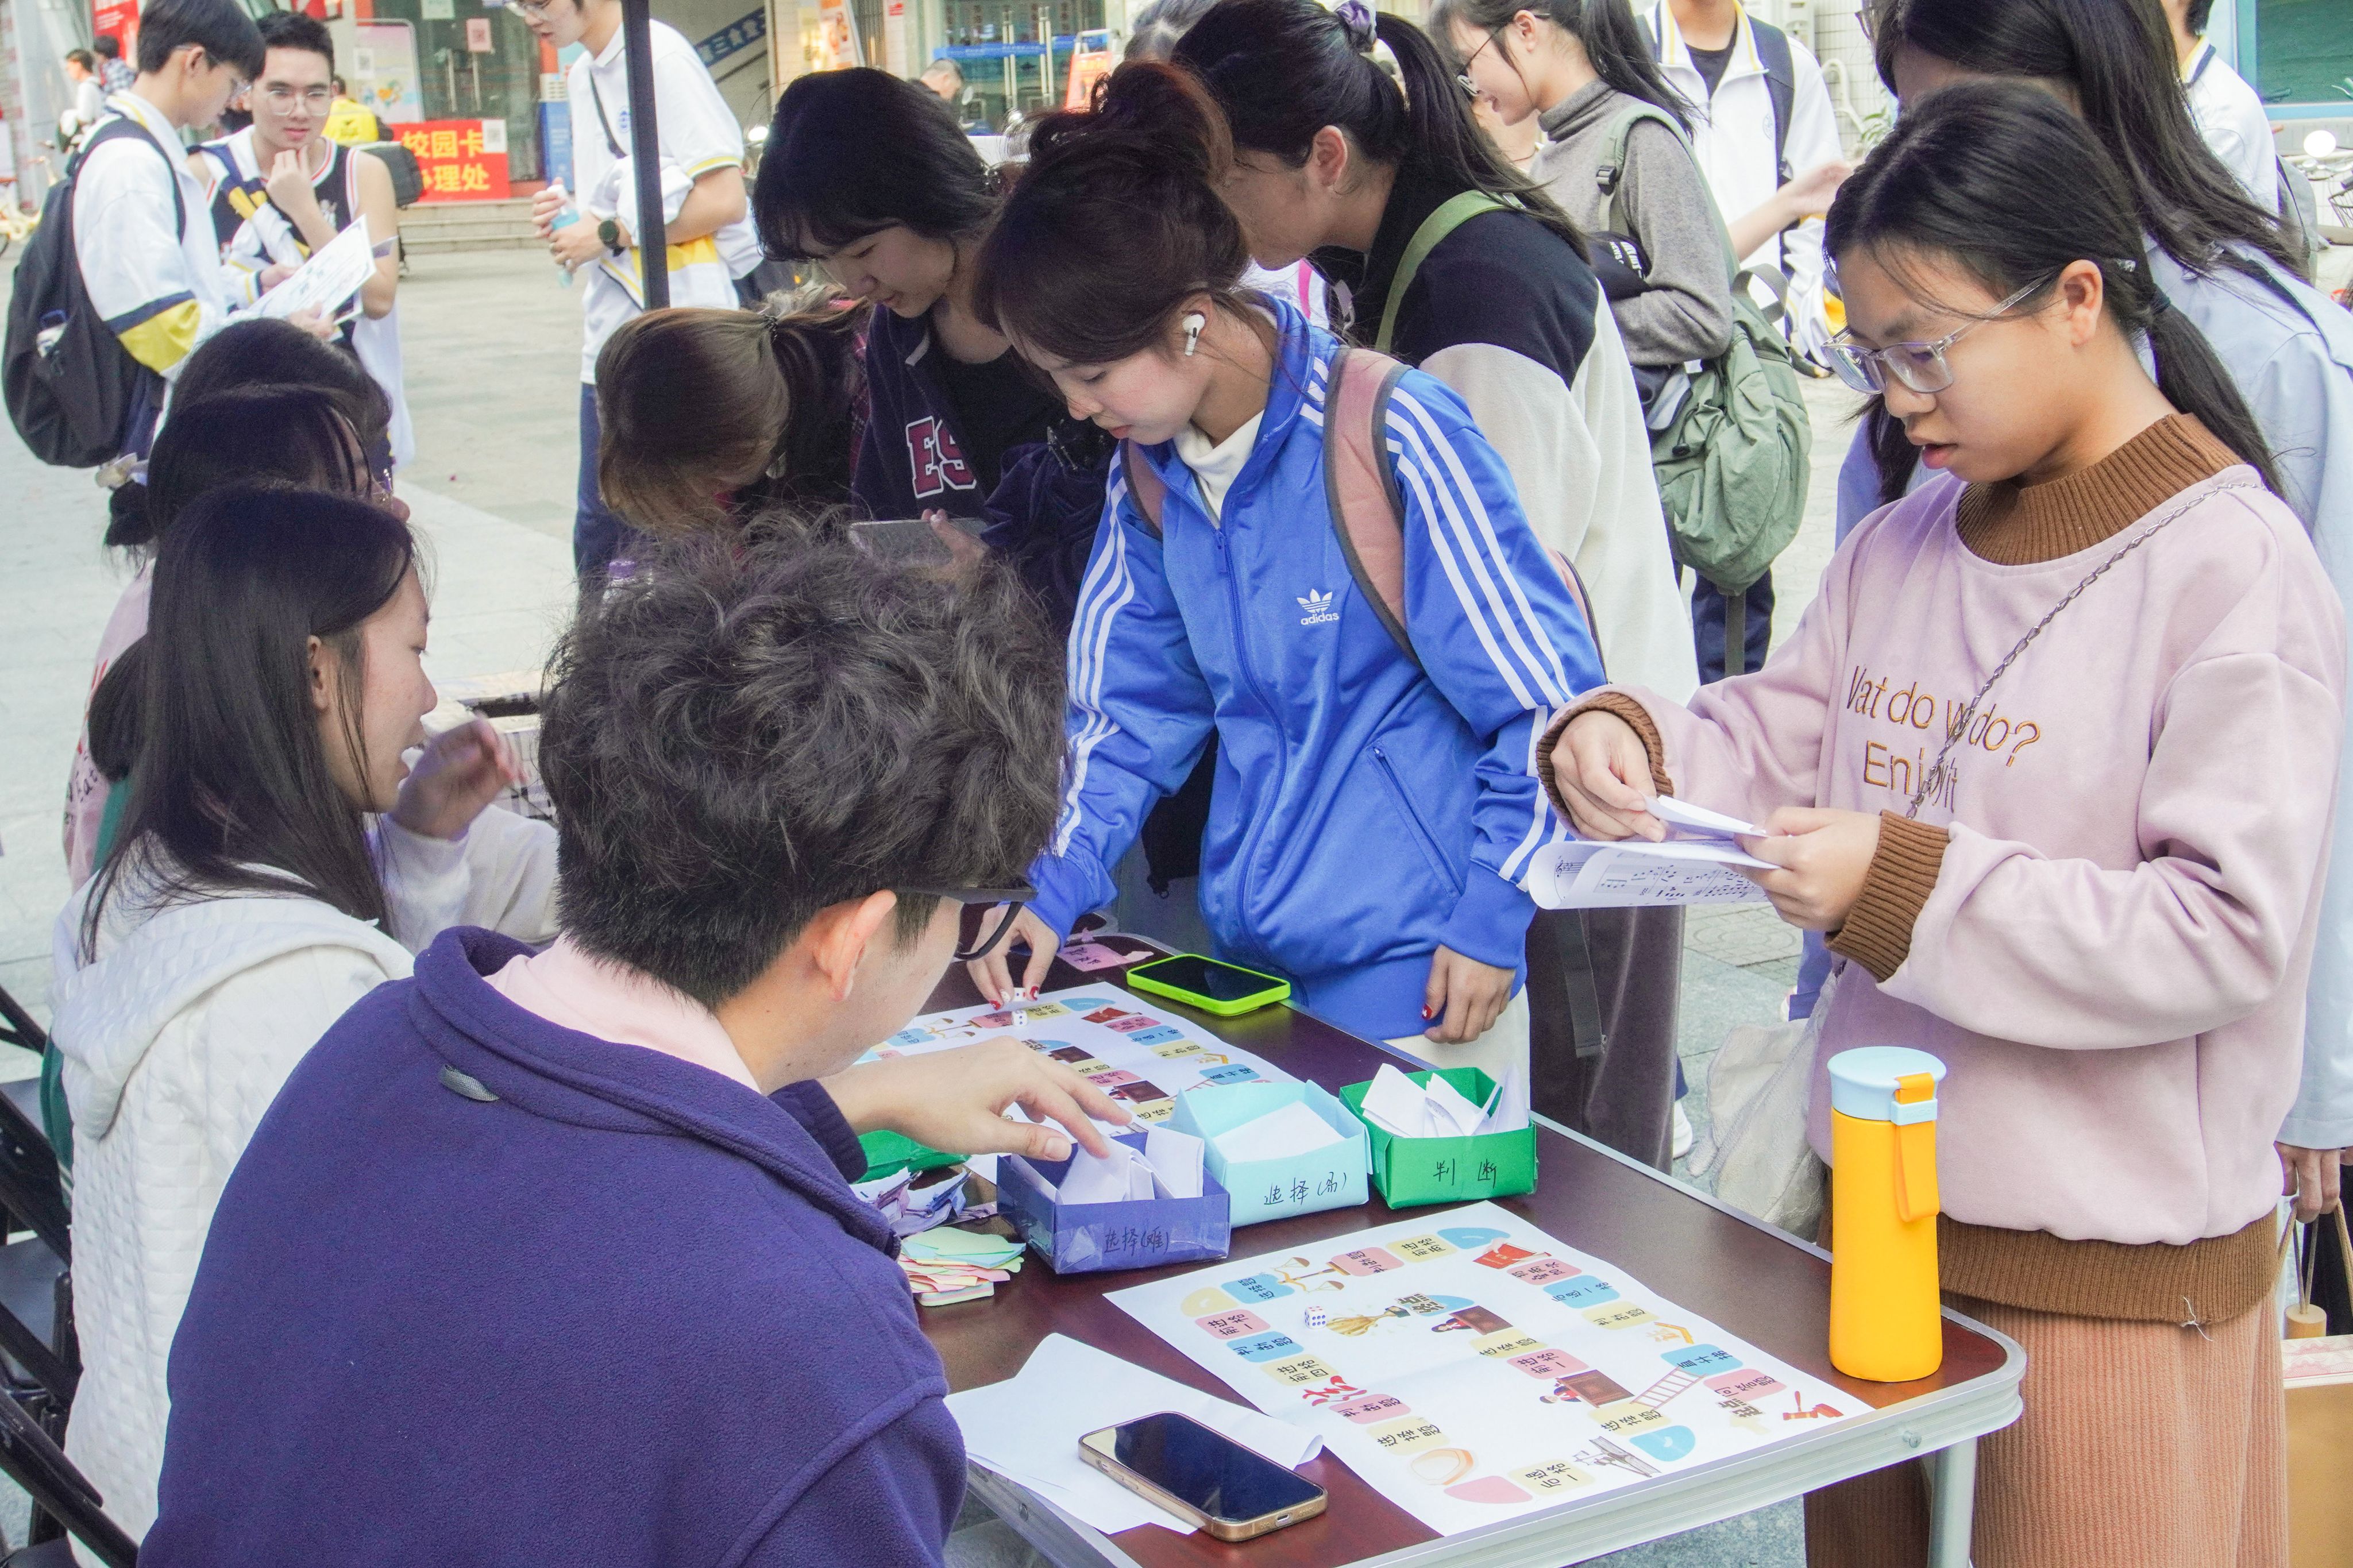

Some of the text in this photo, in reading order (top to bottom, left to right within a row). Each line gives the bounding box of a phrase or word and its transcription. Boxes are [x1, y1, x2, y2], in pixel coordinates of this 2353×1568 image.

[402, 129, 483, 159] 校园卡
[1301, 612, 1339, 625] adidas
[1888, 681, 1935, 729] do
[1137, 1106, 1174, 1119] 选择
[1433, 1158, 1496, 1188] 判断
[1345, 1250, 1387, 1273] 判断题
[1237, 1277, 1275, 1299] 选择题
[1552, 1281, 1612, 1301] 后退一格
[1397, 1293, 1444, 1314] 终点
[1593, 1308, 1645, 1326] 判断题
[1232, 1336, 1293, 1355] 判断题
[1479, 1337, 1537, 1356] 选择题
[1302, 1375, 1366, 1406] 法
[1714, 1375, 1777, 1397] 问答题
[1337, 1397, 1402, 1418] 判断题
[1717, 1397, 1762, 1418] 起点
[1600, 1409, 1663, 1432] 选择题
[1376, 1423, 1441, 1447] 选择题
